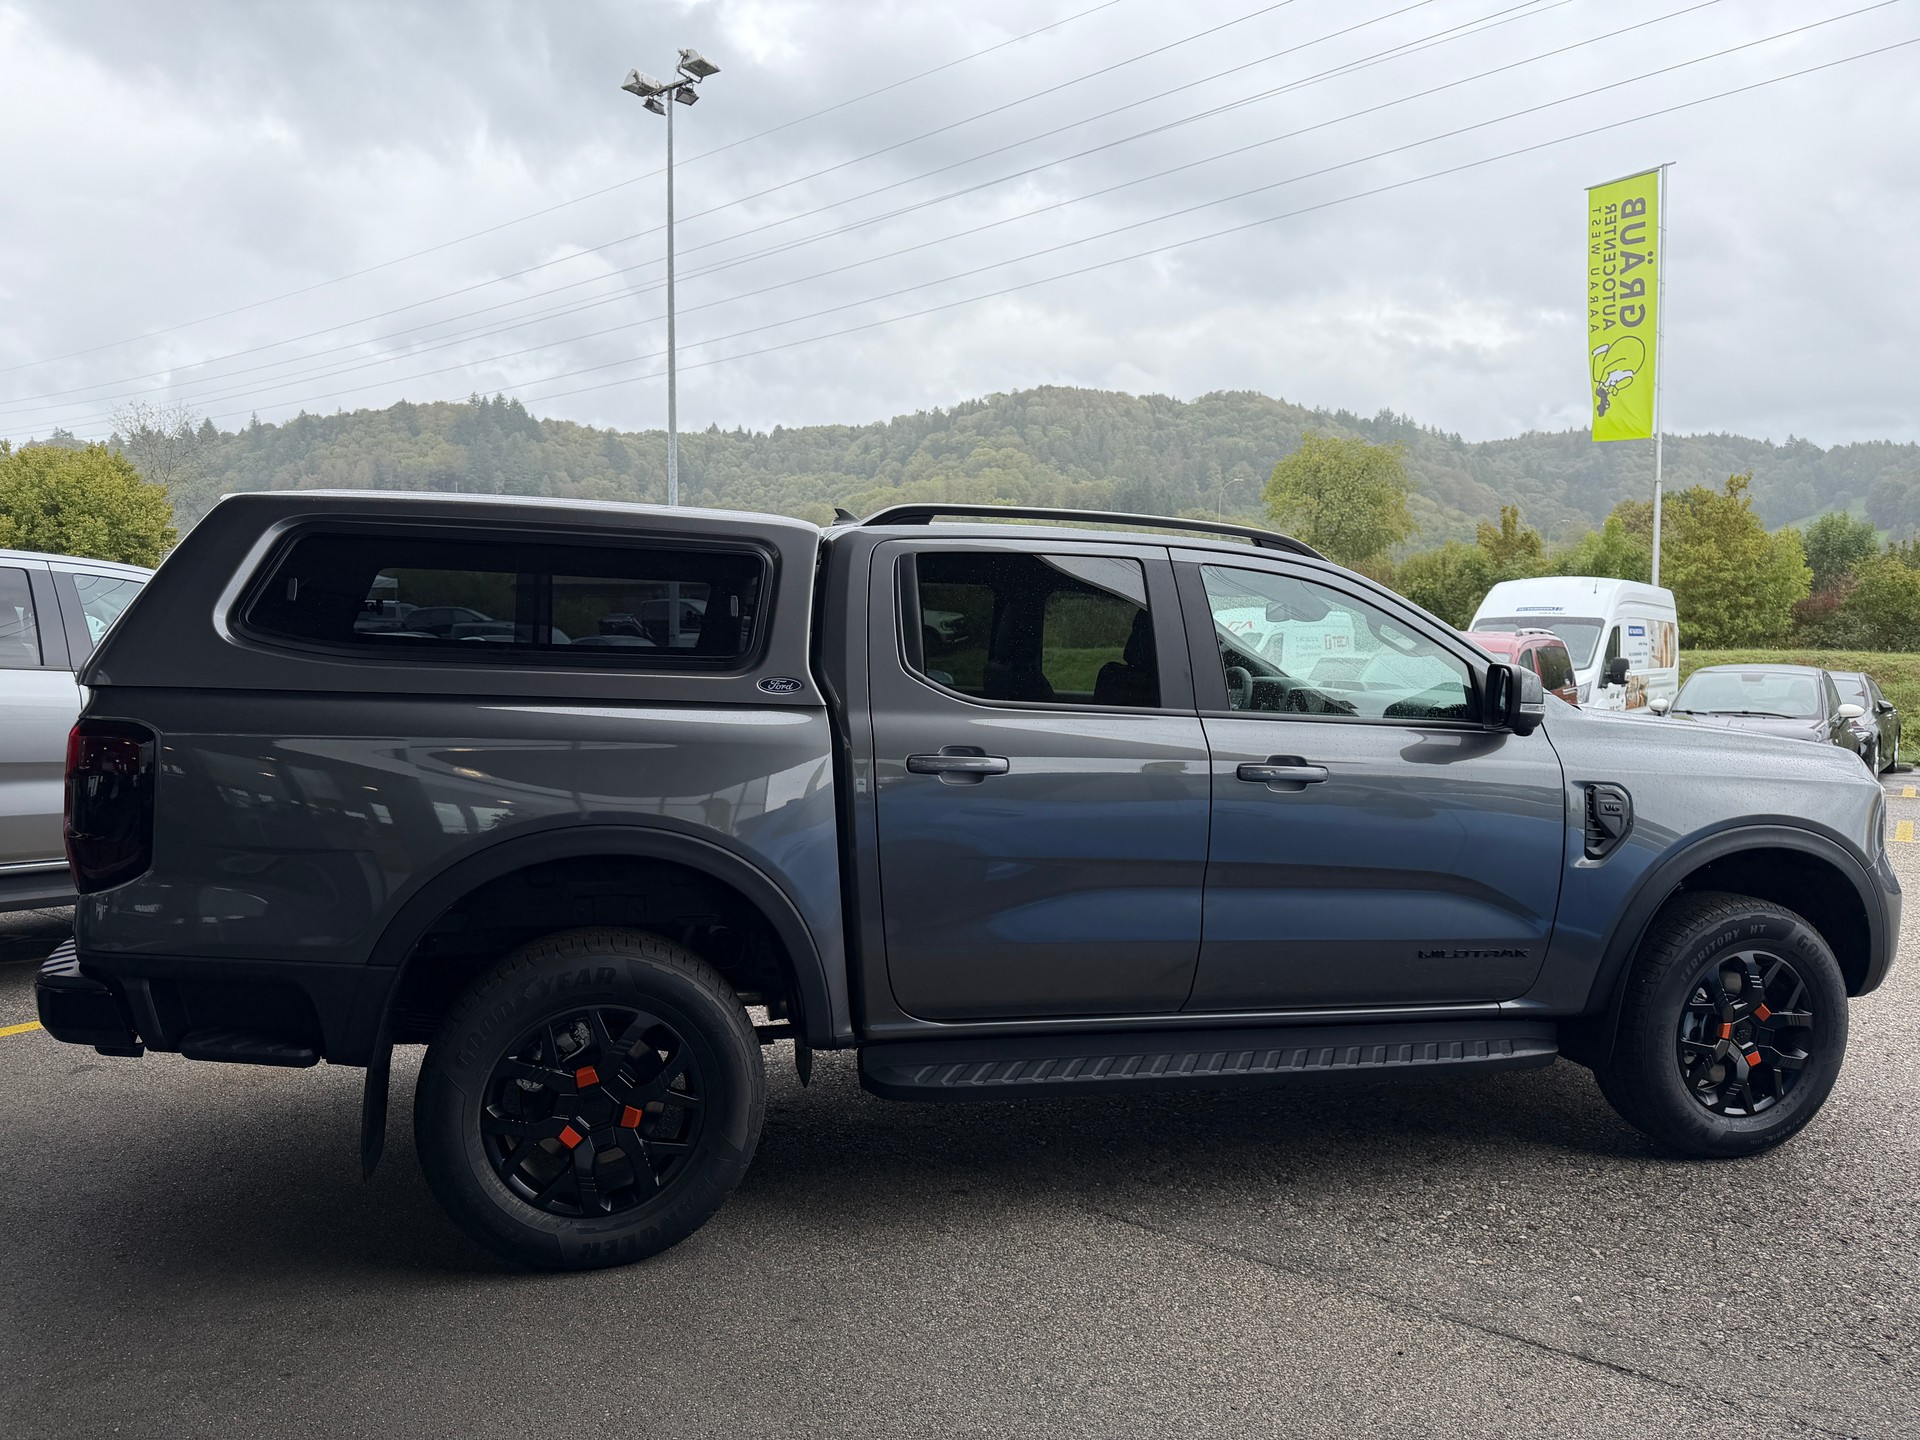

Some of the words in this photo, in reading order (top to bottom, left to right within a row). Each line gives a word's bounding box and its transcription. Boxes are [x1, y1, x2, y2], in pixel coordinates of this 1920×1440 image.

[1418, 949, 1530, 959] WILDTRAK
[1681, 928, 1740, 982] TERRITORY
[1750, 924, 1766, 934] HT
